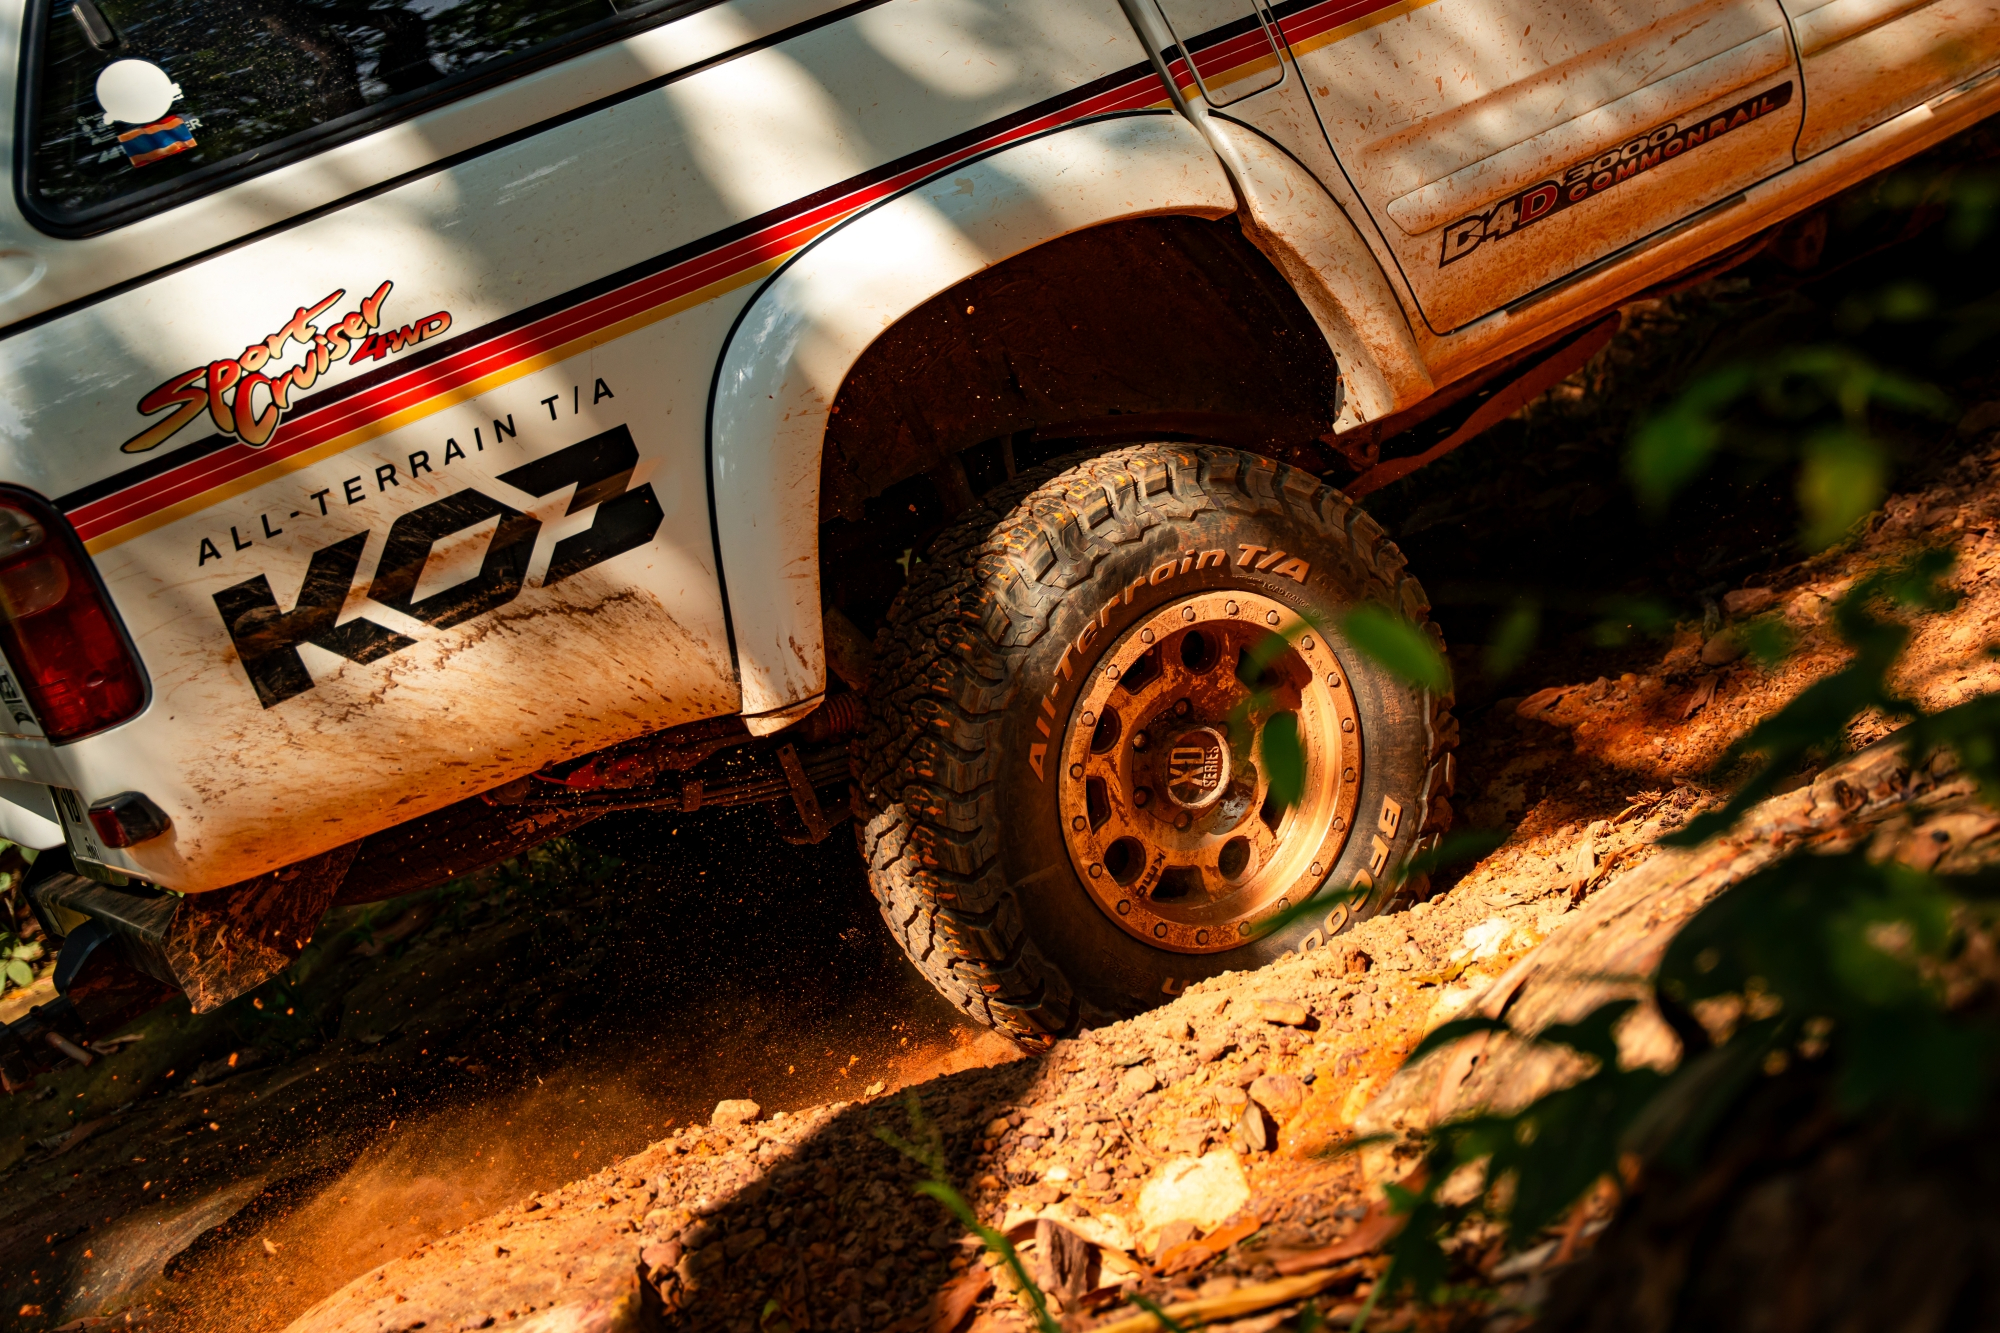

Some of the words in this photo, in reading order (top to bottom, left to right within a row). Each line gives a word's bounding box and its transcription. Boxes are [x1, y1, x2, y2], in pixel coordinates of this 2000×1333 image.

[1562, 123, 1678, 184] 3000
[1568, 95, 1775, 201] COMMONRAIL
[1439, 180, 1559, 269] D4D
[120, 288, 346, 454] Sport
[234, 280, 393, 448] Cruiser
[349, 311, 452, 366] 4WD
[198, 414, 517, 567] ALL-TERRAIN
[541, 377, 615, 421] T/A
[1028, 548, 1226, 783] All-Terrain
[1237, 544, 1311, 585] T/A
[1168, 747, 1204, 786] XD
[1203, 746, 1219, 788] SERIES
